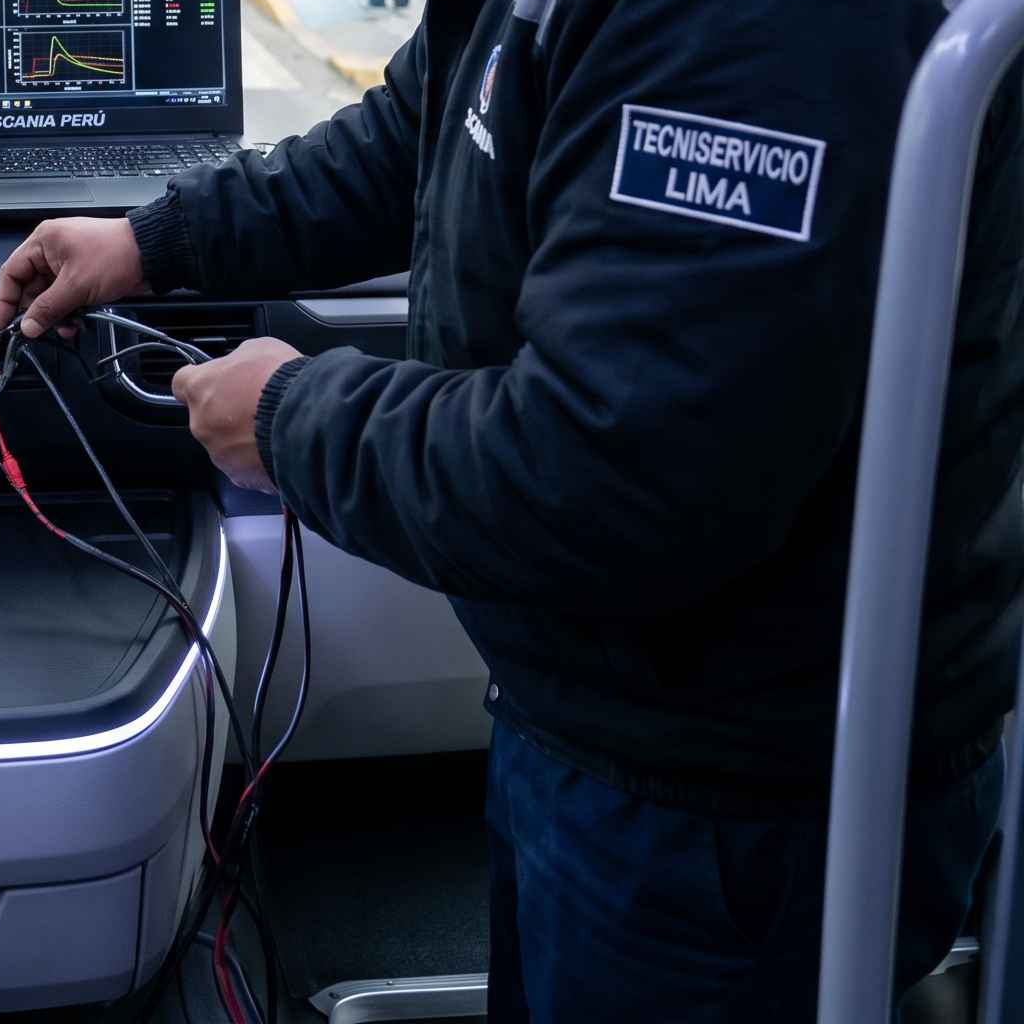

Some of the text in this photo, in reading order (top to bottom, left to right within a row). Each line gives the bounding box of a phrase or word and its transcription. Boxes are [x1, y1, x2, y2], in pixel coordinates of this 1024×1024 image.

[60, 110, 106, 127] PERÚ
[632, 119, 809, 186] TECNISERVICIO
[664, 167, 751, 215] LIMA
